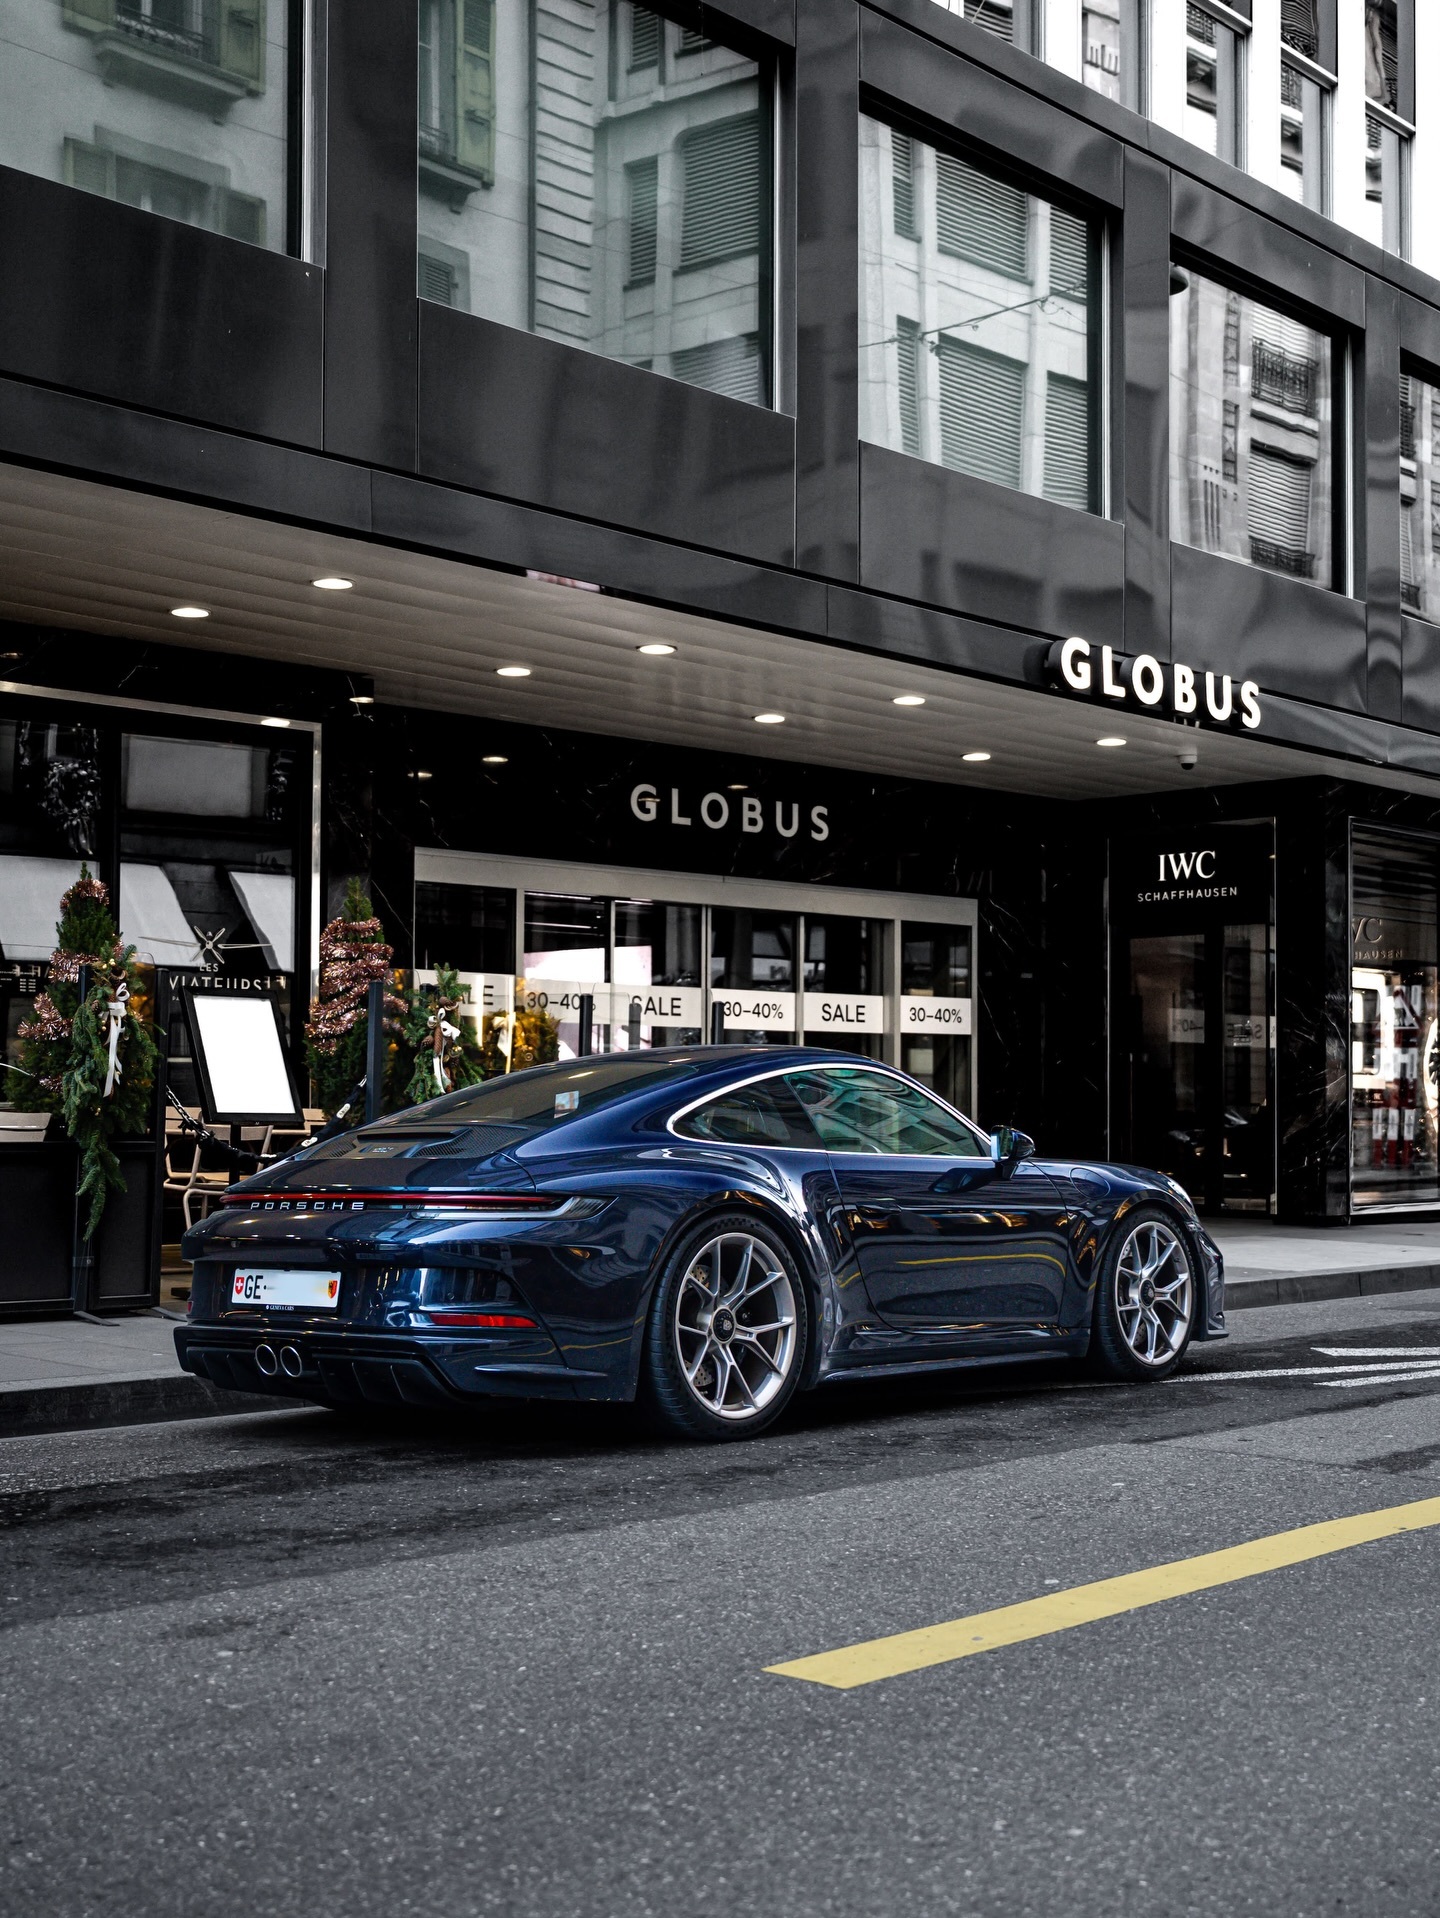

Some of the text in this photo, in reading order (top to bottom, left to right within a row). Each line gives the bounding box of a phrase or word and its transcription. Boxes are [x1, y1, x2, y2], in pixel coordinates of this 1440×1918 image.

[1060, 636, 1261, 730] GLOBUS
[630, 783, 829, 841] GLOBUS
[1158, 850, 1217, 882] IWC
[1137, 886, 1238, 902] SCHAFFHAUSEN
[199, 962, 219, 973] LES
[527, 991, 596, 1011] 30-40
[723, 1001, 784, 1020] 30-40%
[821, 1003, 866, 1023] SALE
[909, 1007, 962, 1024] 30-40%
[250, 1201, 364, 1211] PORSCHE
[244, 1274, 264, 1300] GE
